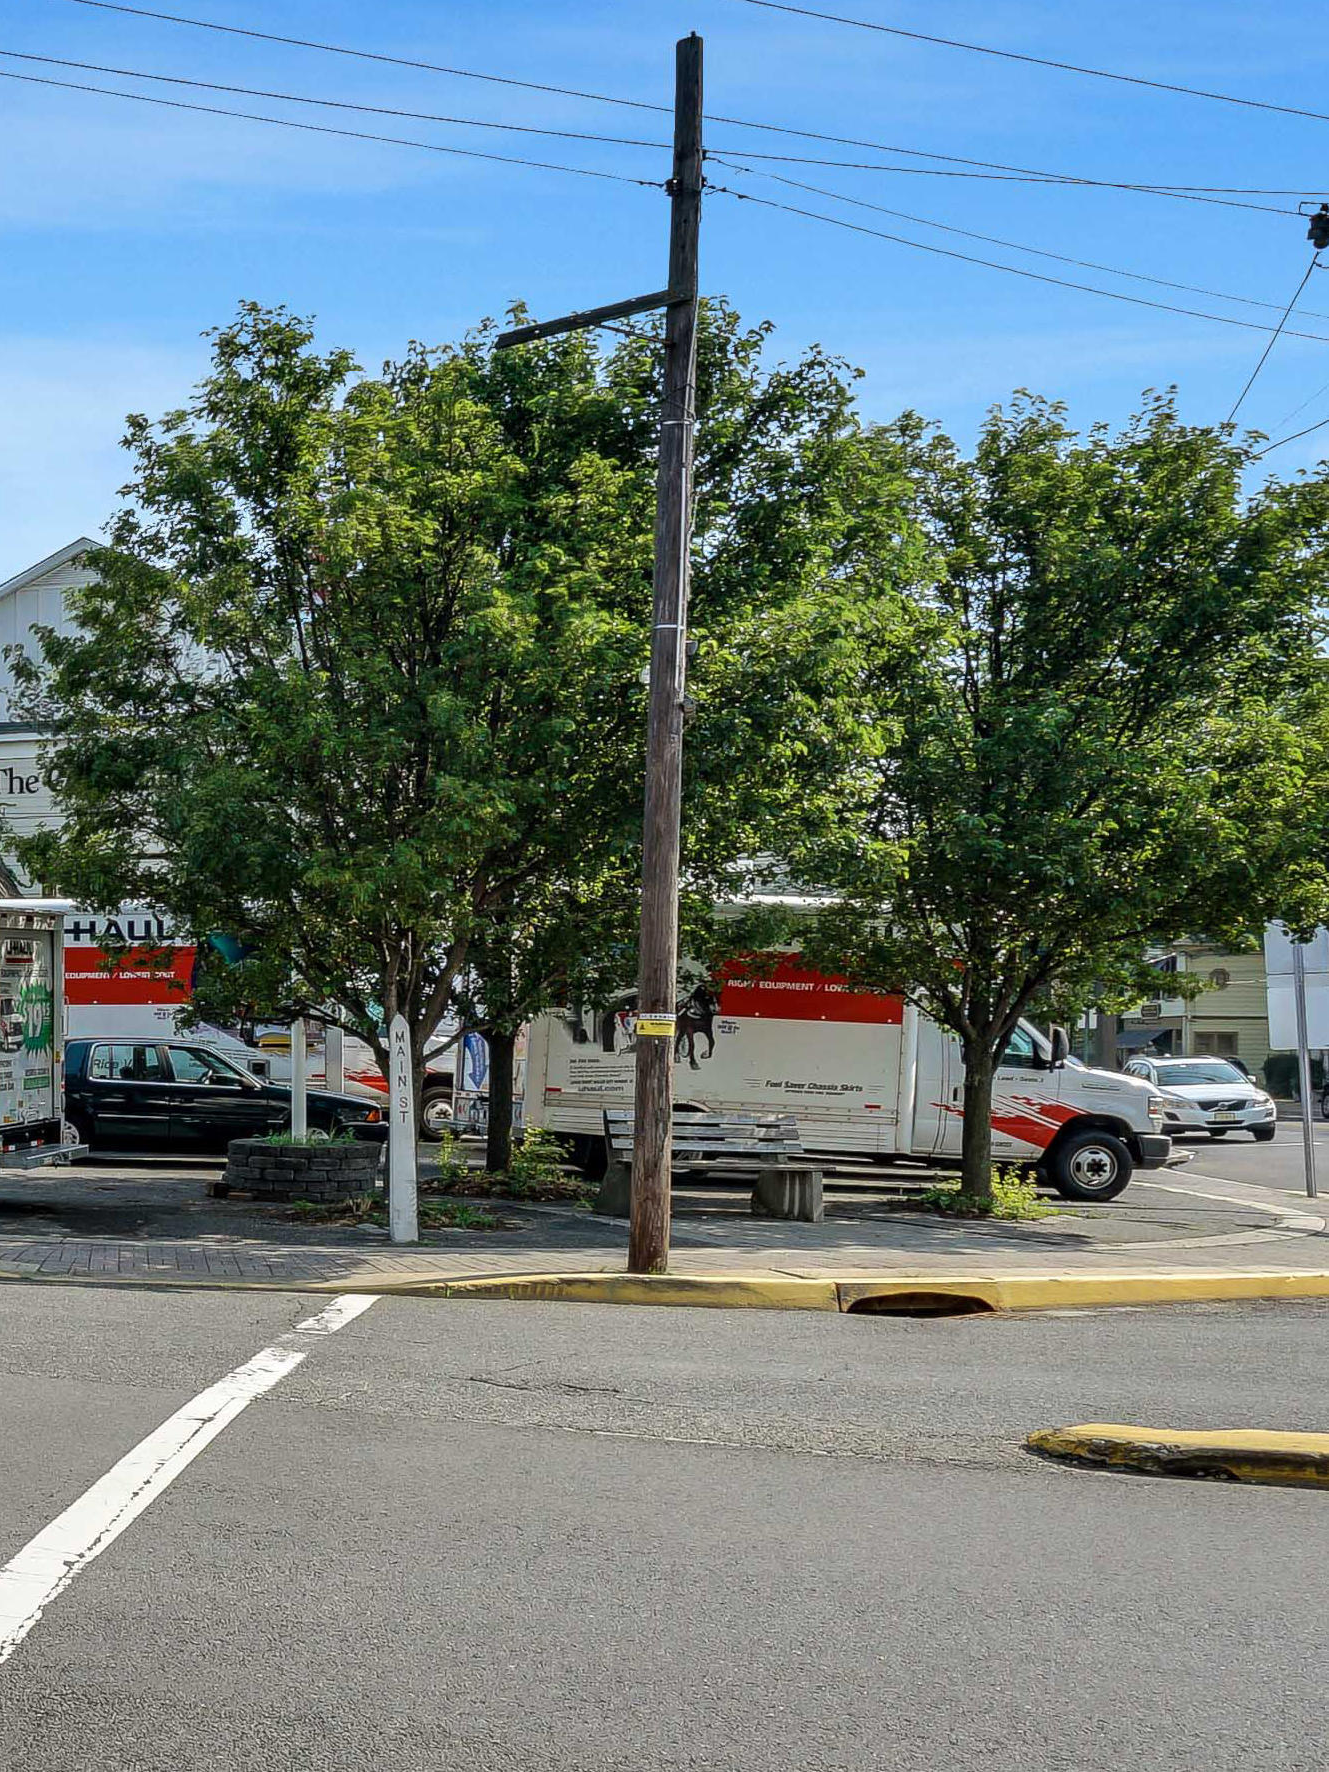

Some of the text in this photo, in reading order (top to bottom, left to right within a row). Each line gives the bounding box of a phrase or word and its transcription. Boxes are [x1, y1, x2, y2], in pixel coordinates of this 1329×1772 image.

[759, 981, 814, 991] EQUIPMENT
[395, 1031, 409, 1124] MAIN ST
